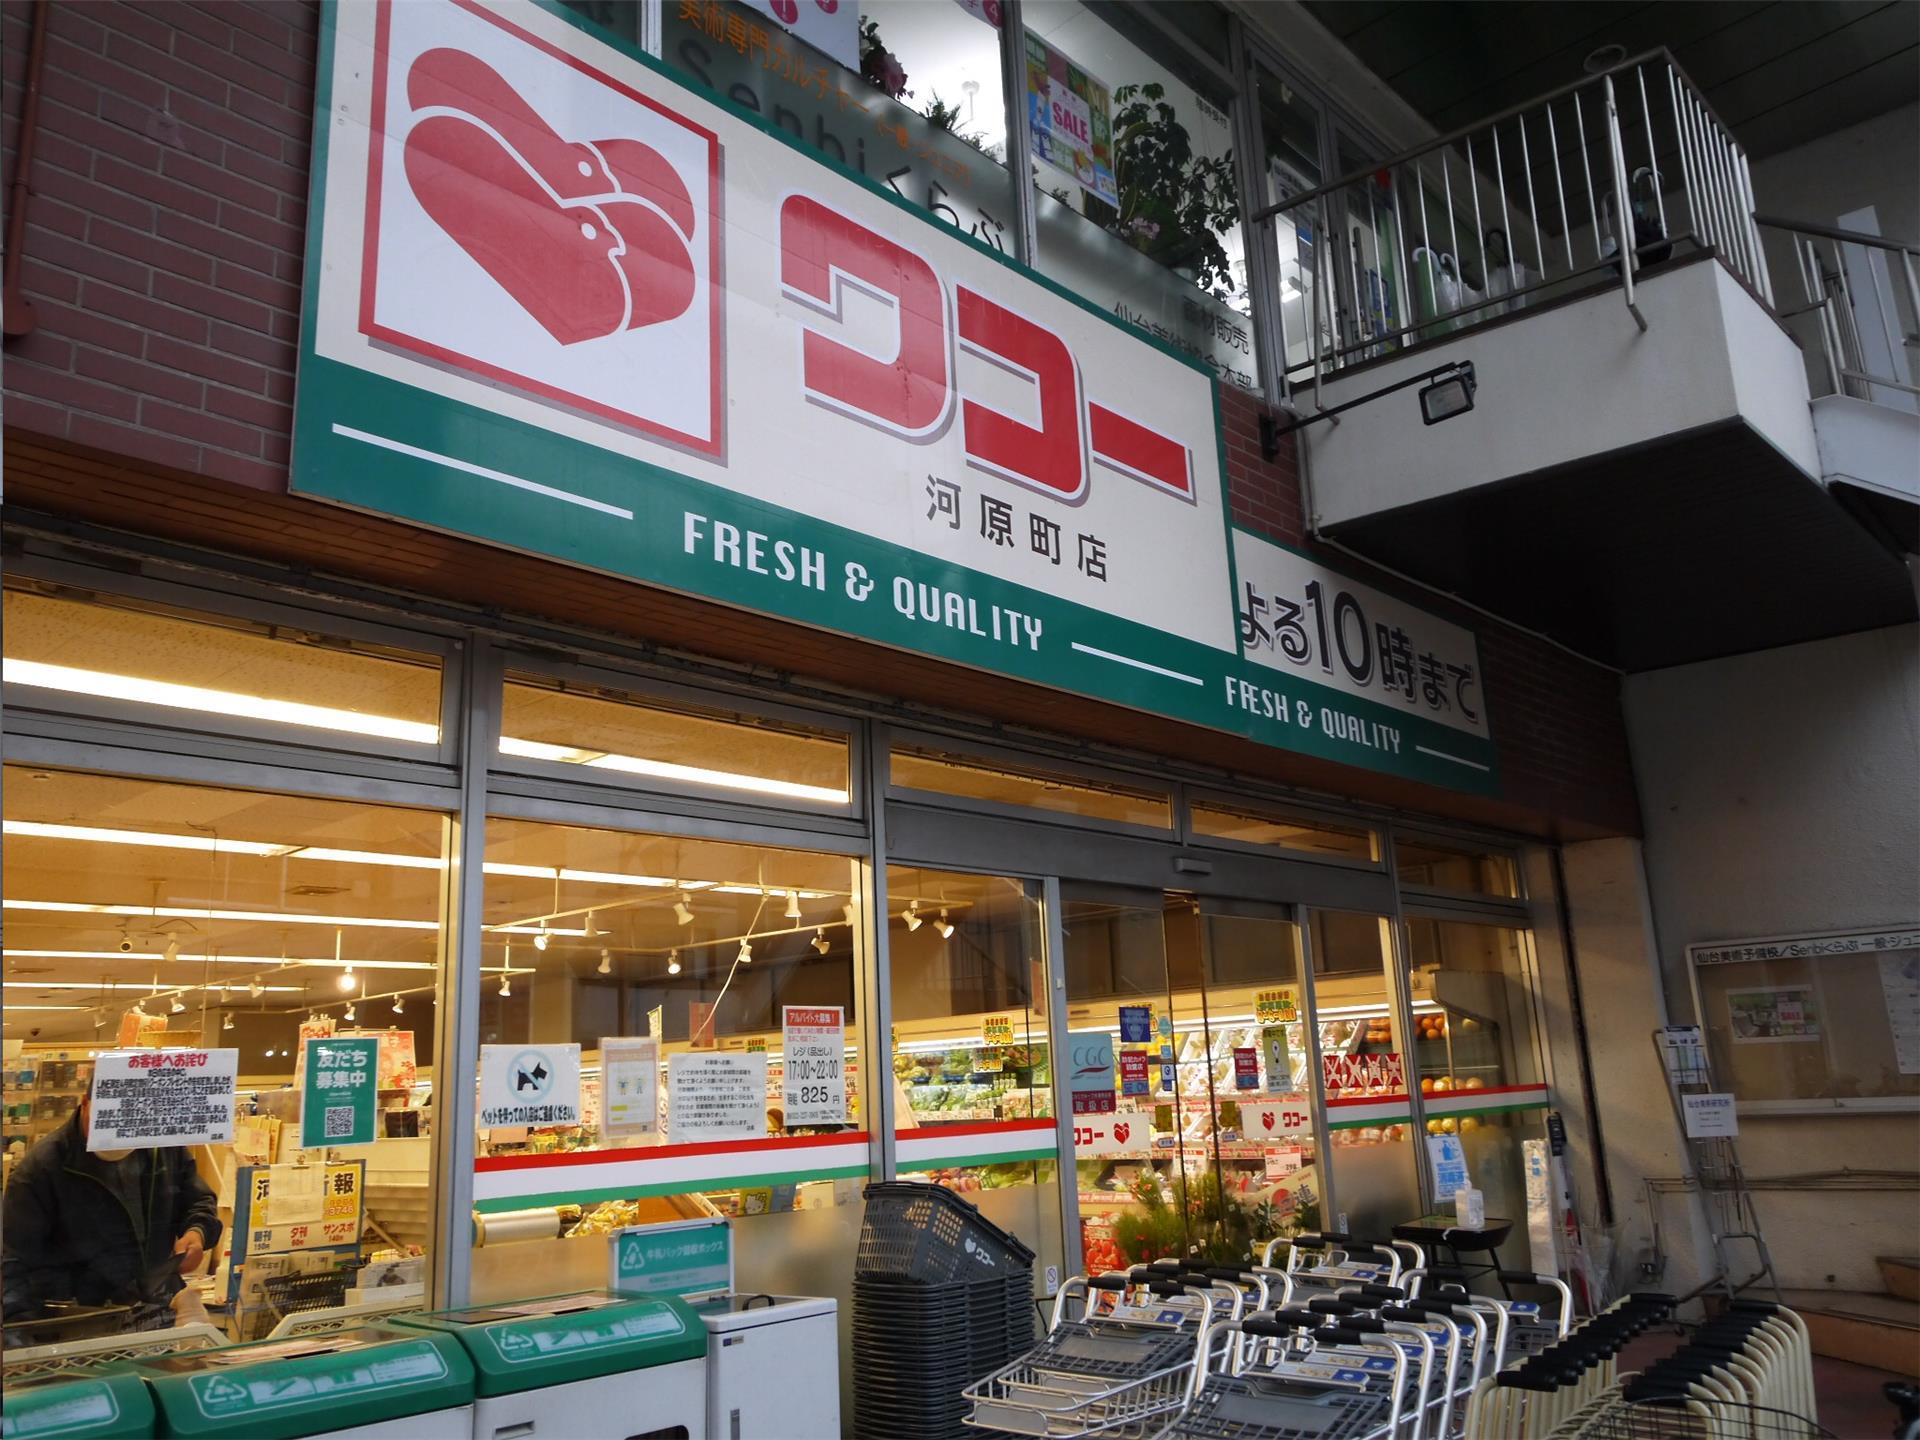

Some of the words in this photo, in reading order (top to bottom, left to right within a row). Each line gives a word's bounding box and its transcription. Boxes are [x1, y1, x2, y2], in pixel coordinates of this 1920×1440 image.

[1052, 101, 1089, 144] SALE
[926, 474, 1107, 582] 河原町店
[684, 511, 825, 591] FRESH
[845, 562, 874, 602] &
[893, 576, 1042, 651] QUALITY
[1240, 580, 1478, 724] よる10時まで
[1225, 676, 1289, 723] FRESH
[1296, 700, 1312, 728] &
[1321, 707, 1401, 754] QUALITY
[317, 1047, 368, 1068] 友だち
[1073, 1046, 1107, 1067] CGC
[316, 1070, 367, 1089] 募集中
[801, 1086, 829, 1104] 825
[832, 1095, 840, 1105] 円
[290, 1226, 308, 1239] 夕刊
[323, 1222, 354, 1235] サンスポ
